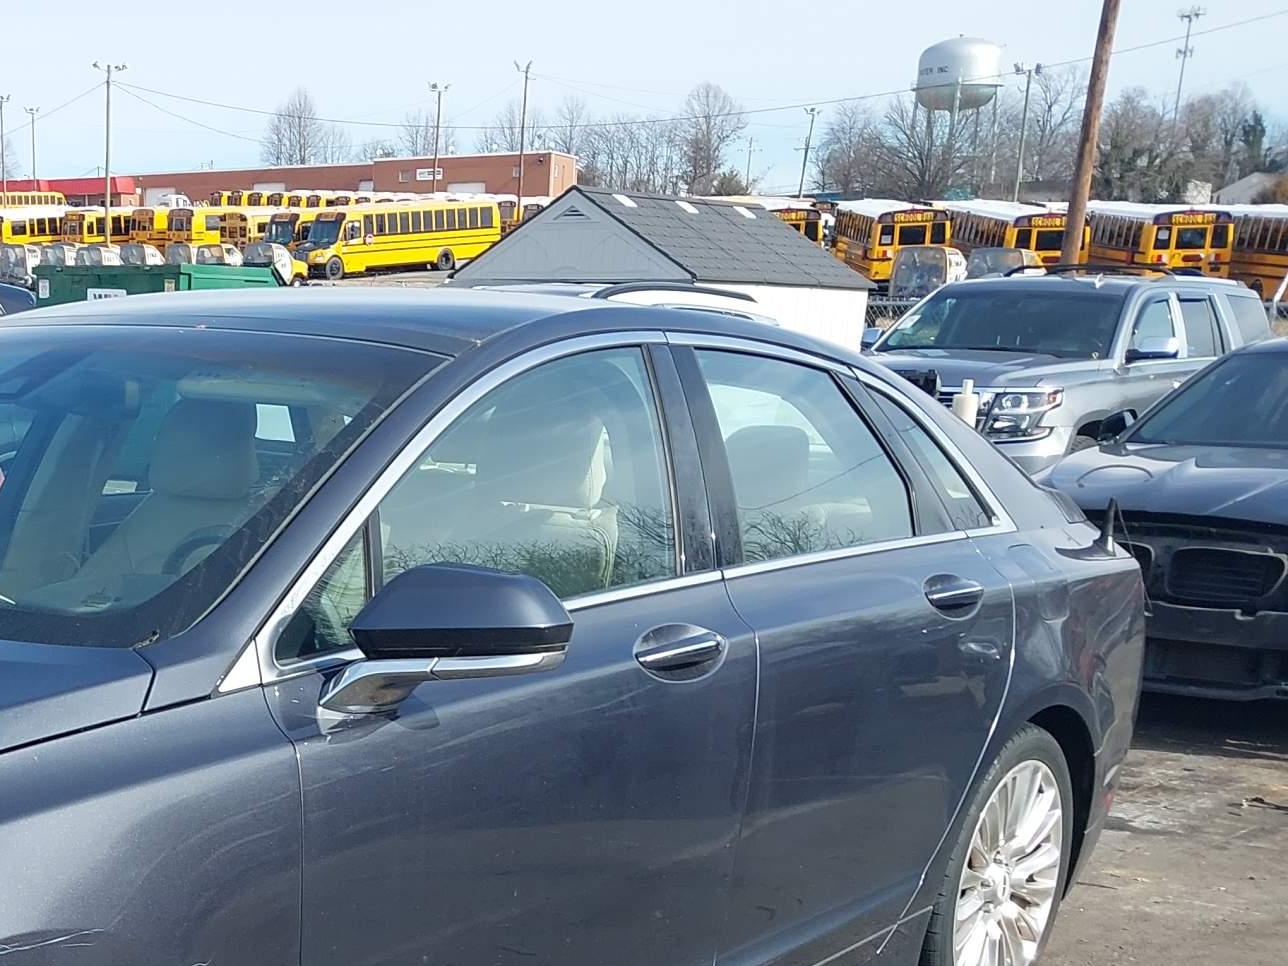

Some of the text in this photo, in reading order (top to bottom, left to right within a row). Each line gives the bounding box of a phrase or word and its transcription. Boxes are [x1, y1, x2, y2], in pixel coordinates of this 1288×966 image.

[895, 213, 922, 222] SCHOOL
[1032, 217, 1061, 226] SCHOOL
[1172, 214, 1203, 224] SCHOOL
